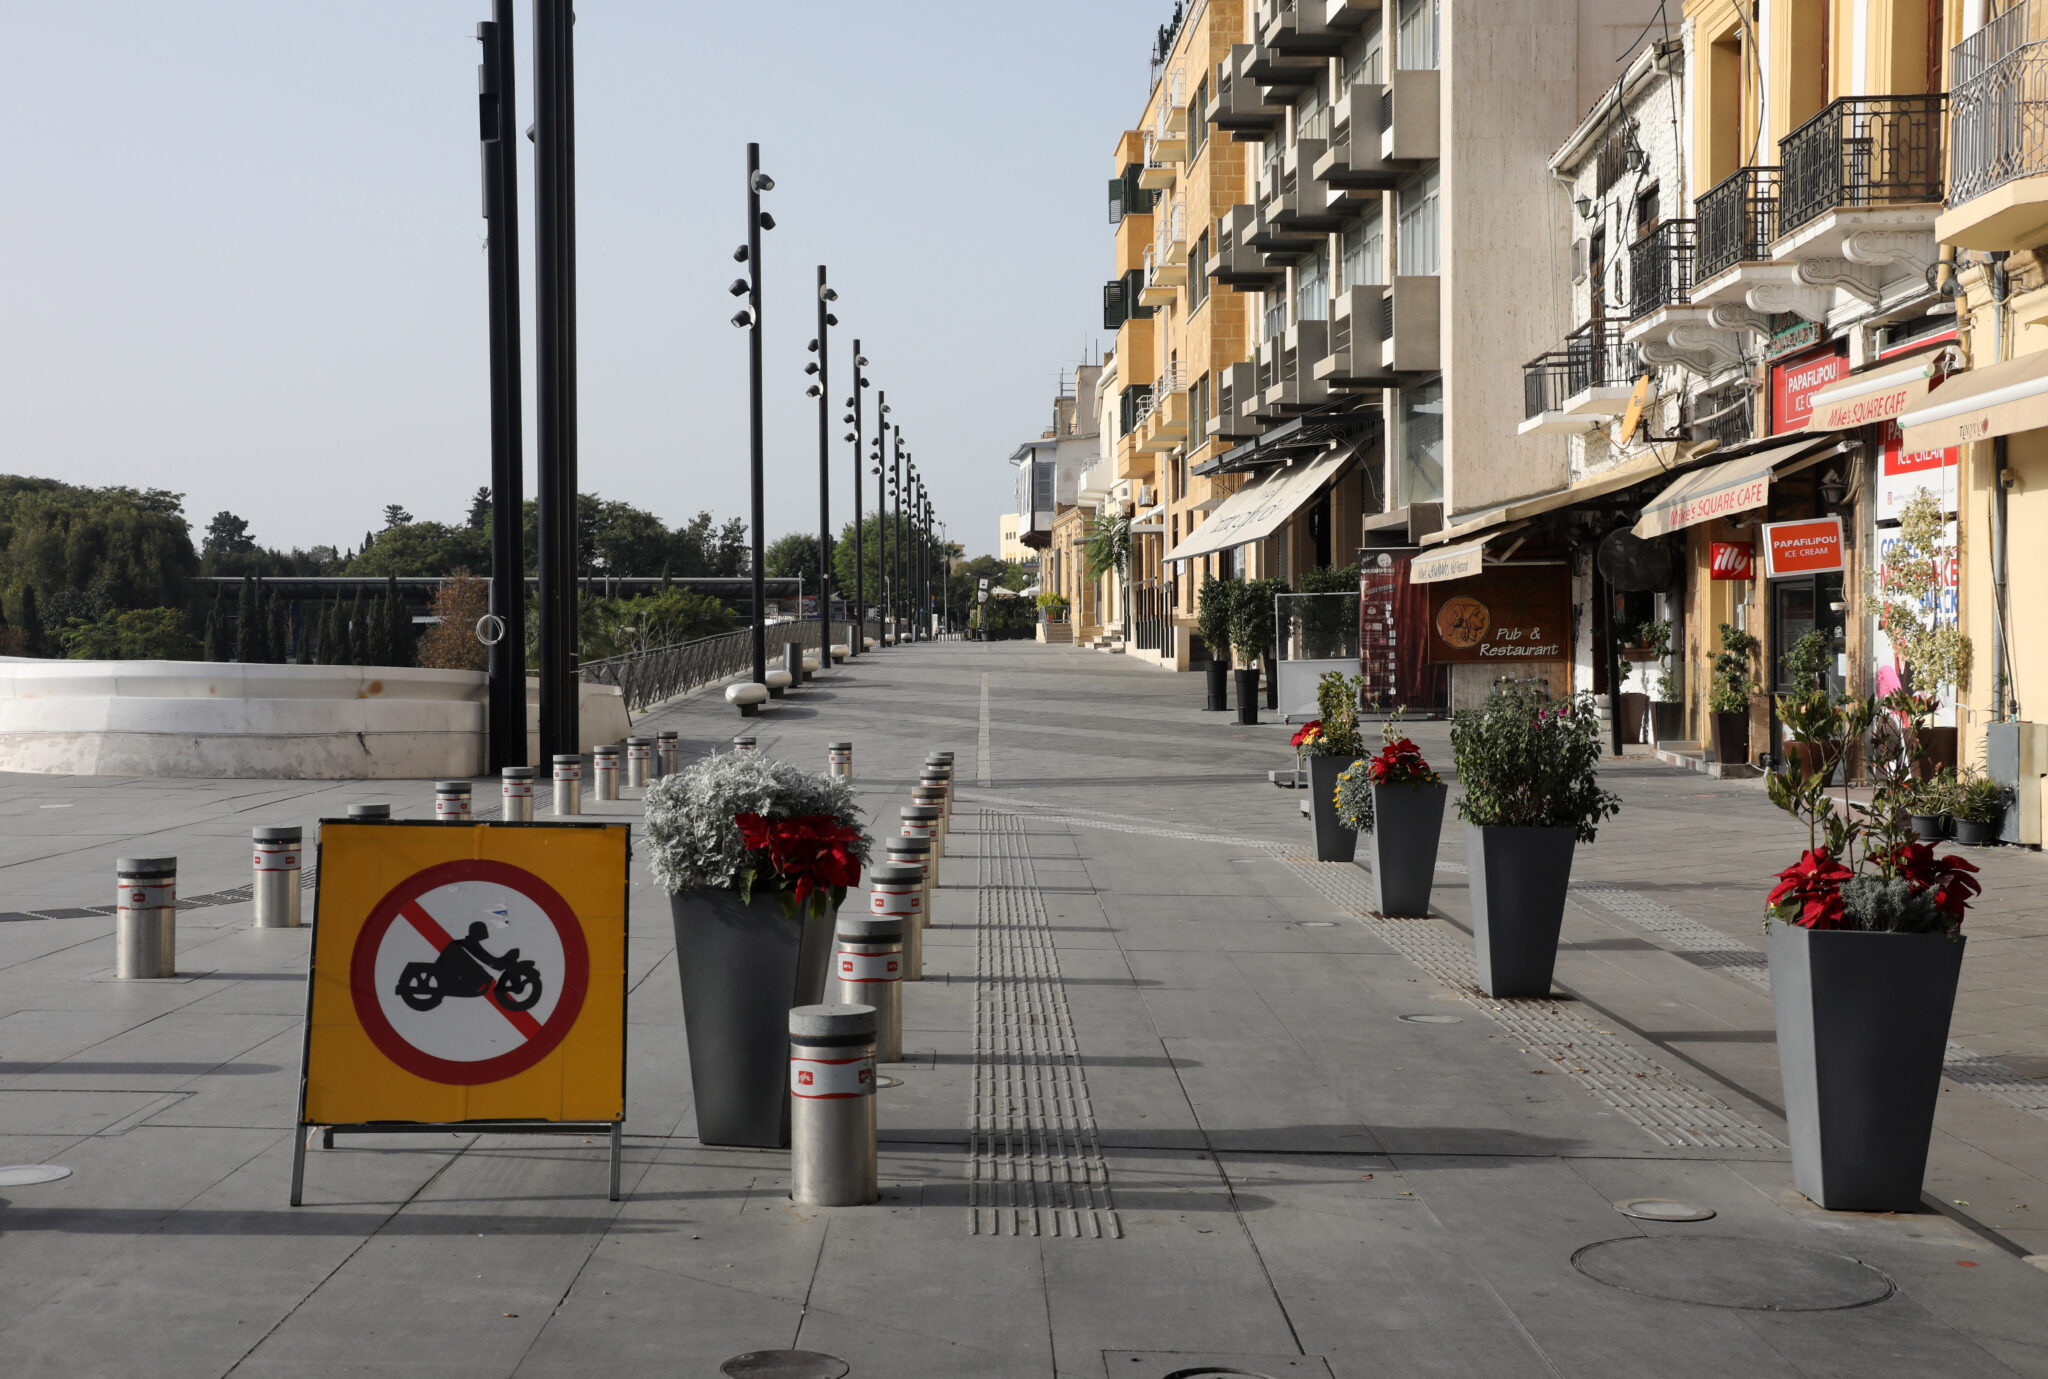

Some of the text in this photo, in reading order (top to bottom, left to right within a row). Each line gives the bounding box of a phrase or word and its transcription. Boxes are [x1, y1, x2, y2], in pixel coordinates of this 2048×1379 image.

[1852, 397, 1884, 423] SQUARE
[1670, 483, 1763, 526] Mike's SQUARE CAFE
[1714, 547, 1748, 576] illy
[1785, 547, 1828, 558] ICE CREAM
[1496, 626, 1541, 640] Pub &
[1479, 643, 1559, 657] Restaurant
